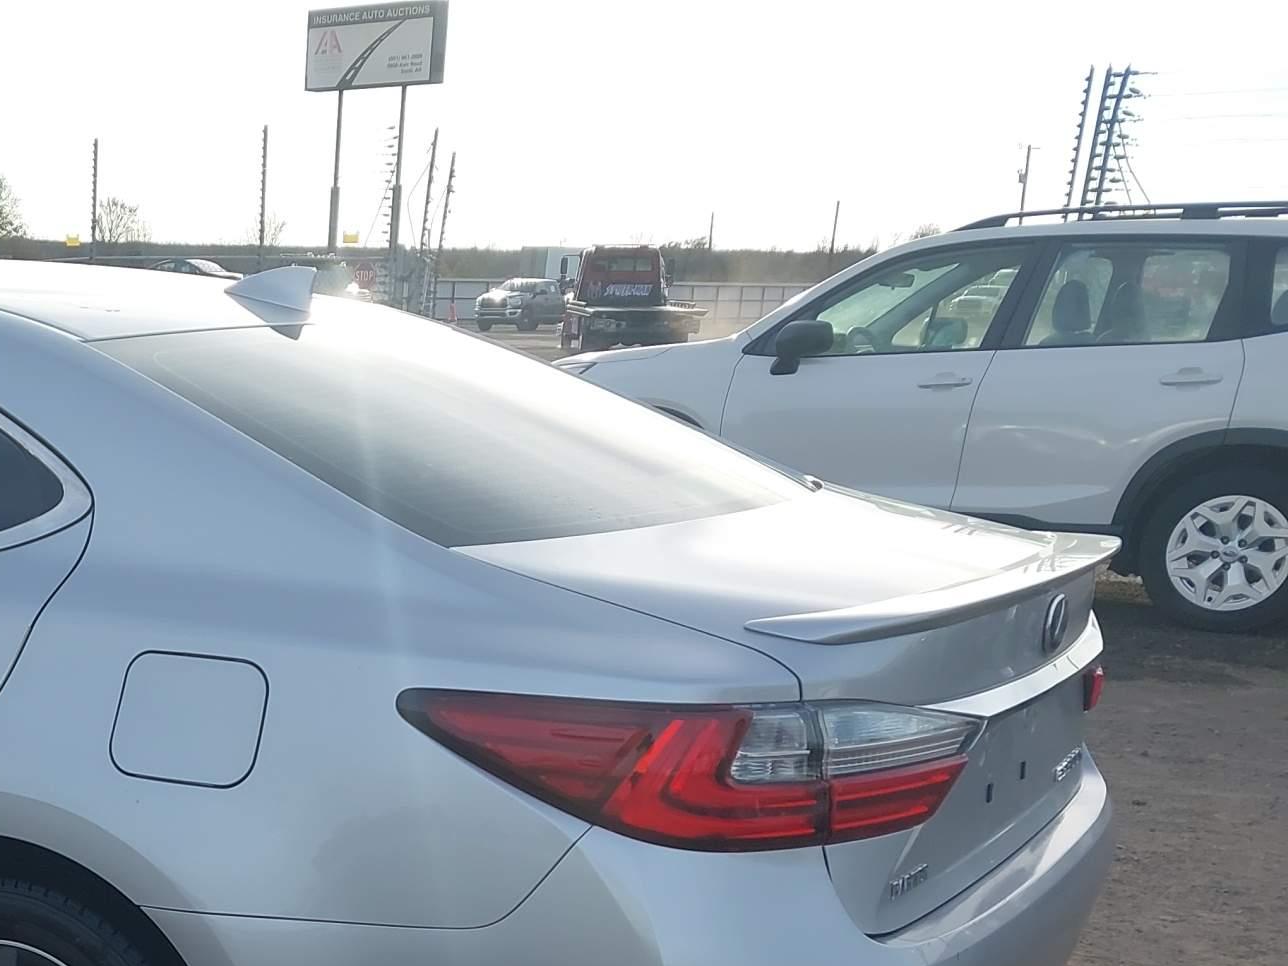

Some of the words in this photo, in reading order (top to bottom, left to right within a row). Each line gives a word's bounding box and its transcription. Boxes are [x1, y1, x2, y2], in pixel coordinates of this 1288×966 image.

[313, 12, 360, 25] INSURANCE
[362, 10, 384, 20] AUTO
[387, 5, 430, 17] AUCTIONS
[355, 270, 374, 281] STOP
